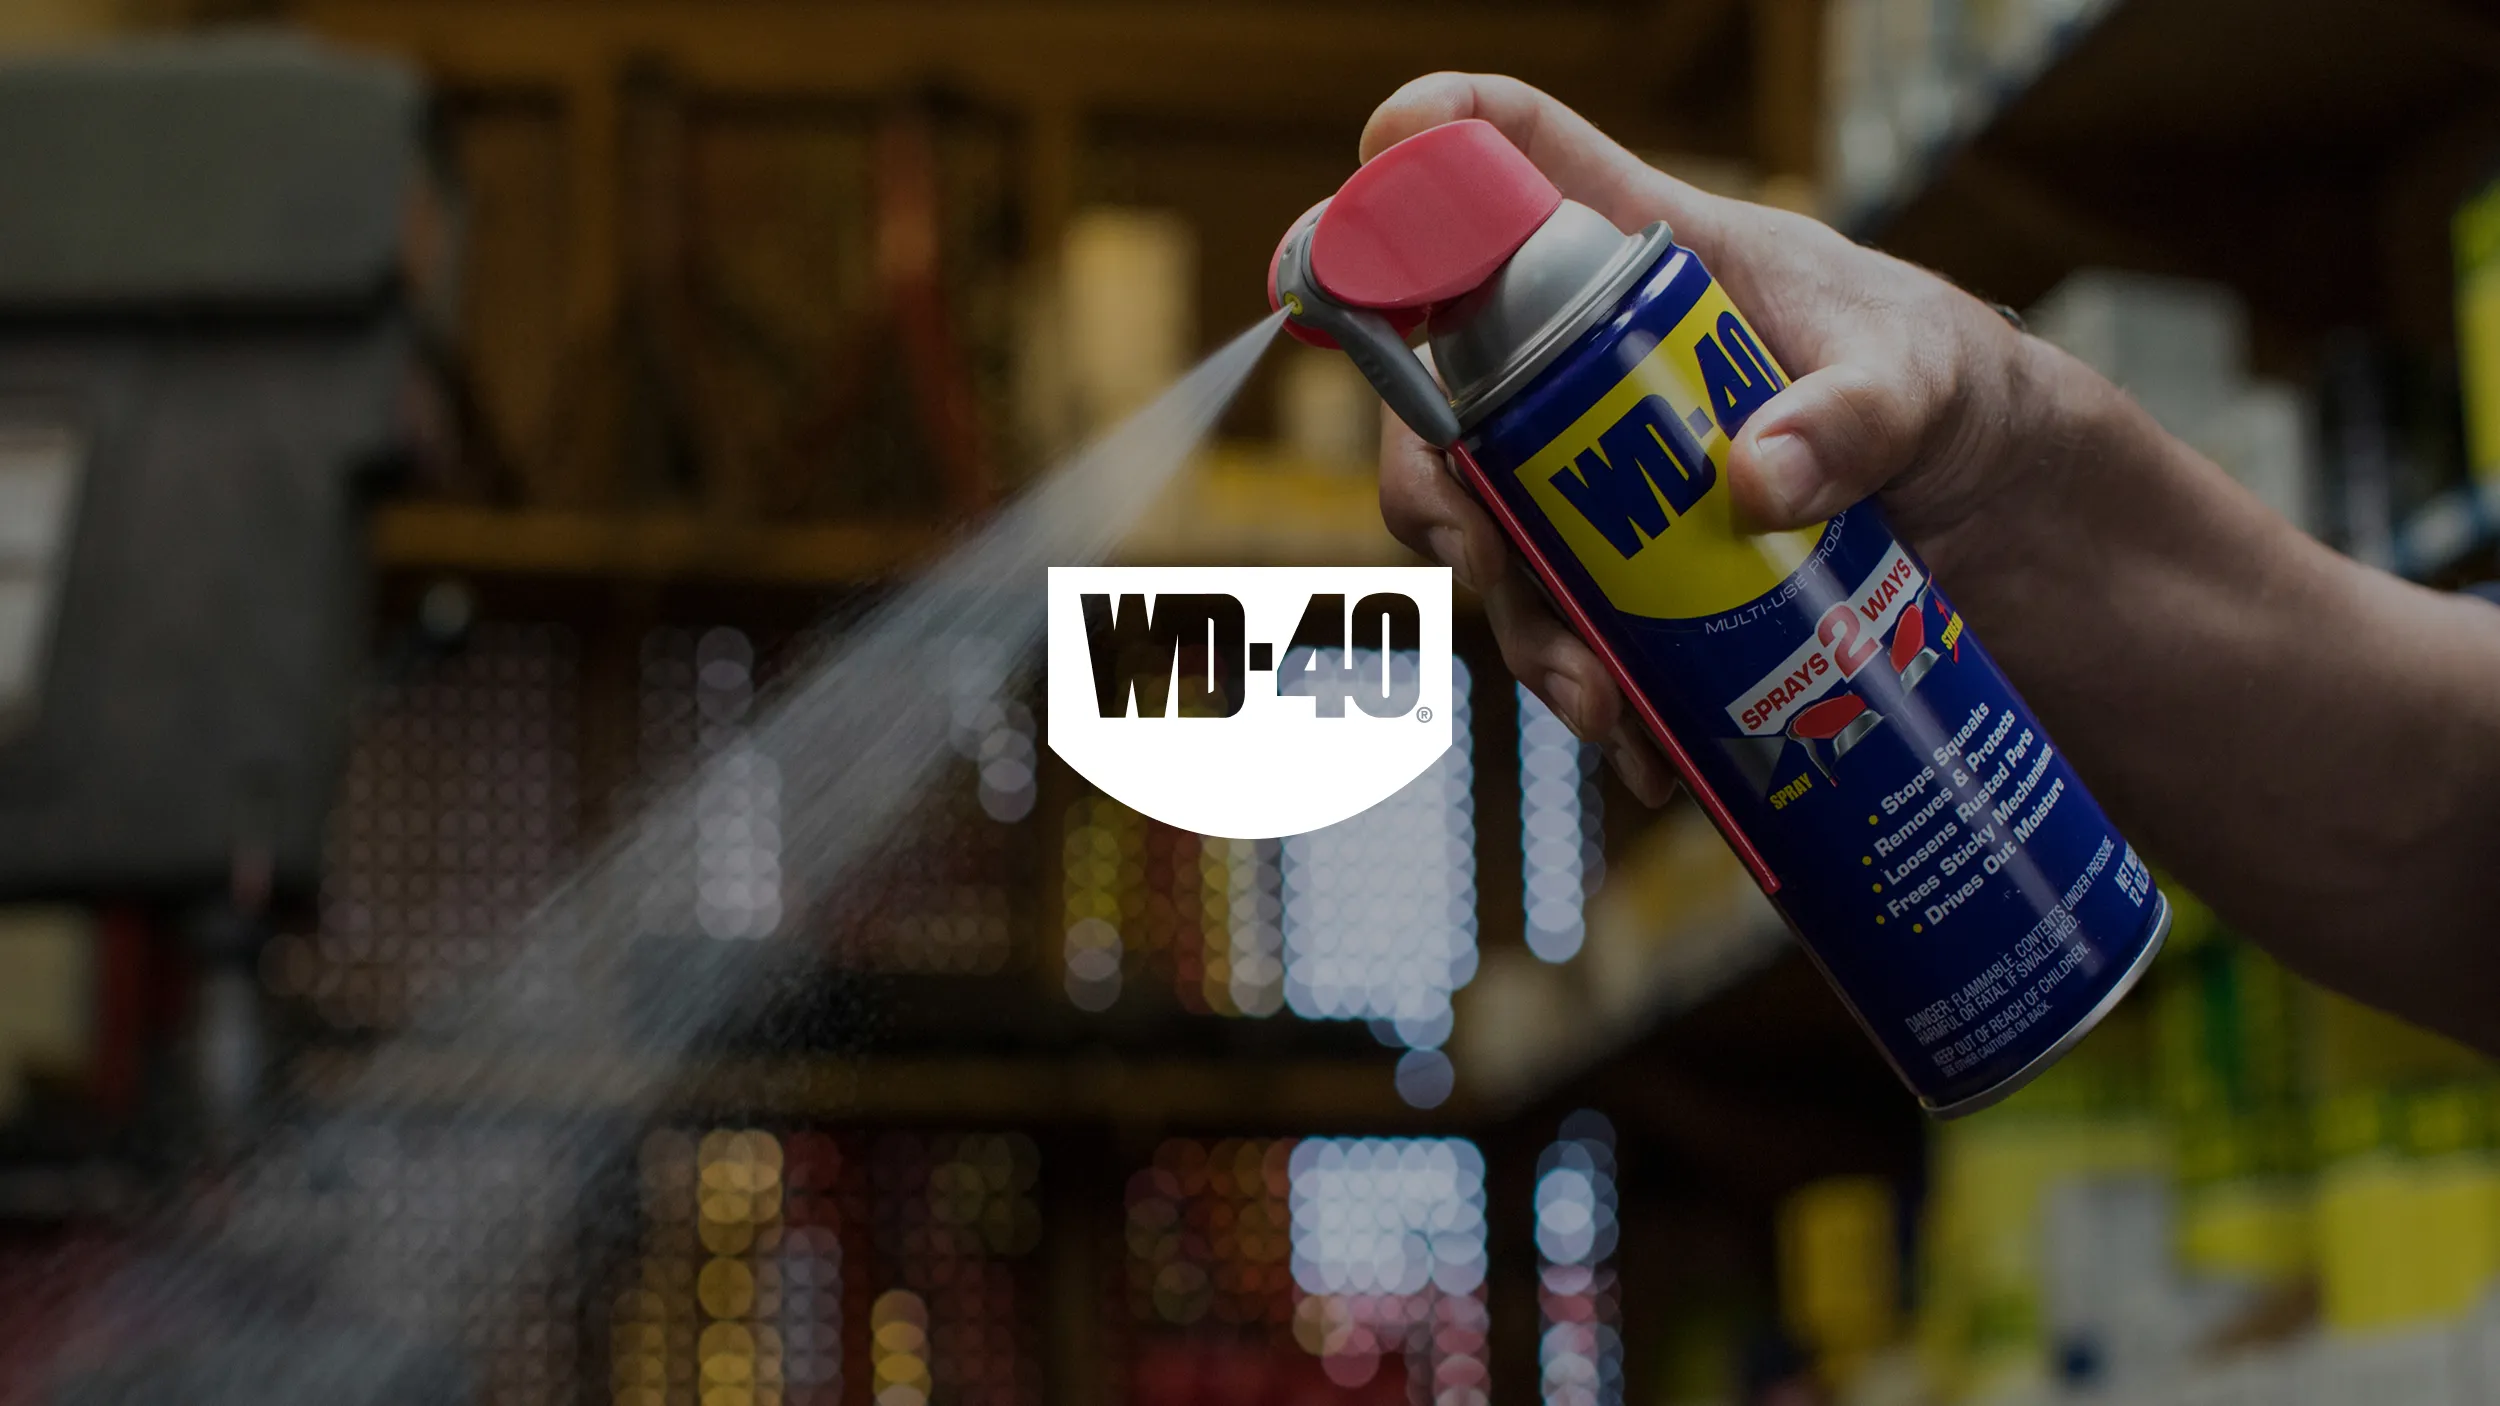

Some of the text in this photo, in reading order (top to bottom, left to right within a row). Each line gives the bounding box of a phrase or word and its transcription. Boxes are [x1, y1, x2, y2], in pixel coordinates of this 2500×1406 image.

[1548, 311, 1785, 560] WD-40
[1704, 510, 1847, 635] MULTI-USE PRODU
[1741, 557, 1911, 730] SPRAYS 2 WAYS
[1769, 772, 1814, 811] SPRAY
[1873, 709, 2016, 858] Removes & Protects
[1880, 702, 1990, 815] Stops Squeaks
[1883, 727, 2034, 886] Loosens Rusted Parts
[1886, 743, 2054, 919] Frees Sticky Mechanisms
[1924, 777, 2064, 926] Drives Out Moisture
[2114, 861, 2134, 893] NET
[1904, 1000, 1955, 1034] DANGER:
[1951, 953, 2019, 1008] FLAMMABLE.
[2015, 904, 2066, 958] CONTENTS
[2061, 874, 2092, 911] UNDER
[1915, 914, 2081, 1046] HARMFUL OR FATAL IF SWALLOWED.
[1931, 941, 2091, 1067] KEEP OUT OF REACH OF CHILDREN.
[1955, 1054, 1979, 1073] OTHER
[1977, 1027, 2017, 1060] CAUTIONS
[2014, 1018, 2031, 1033] ON
[2027, 1000, 2053, 1023] BACK.
